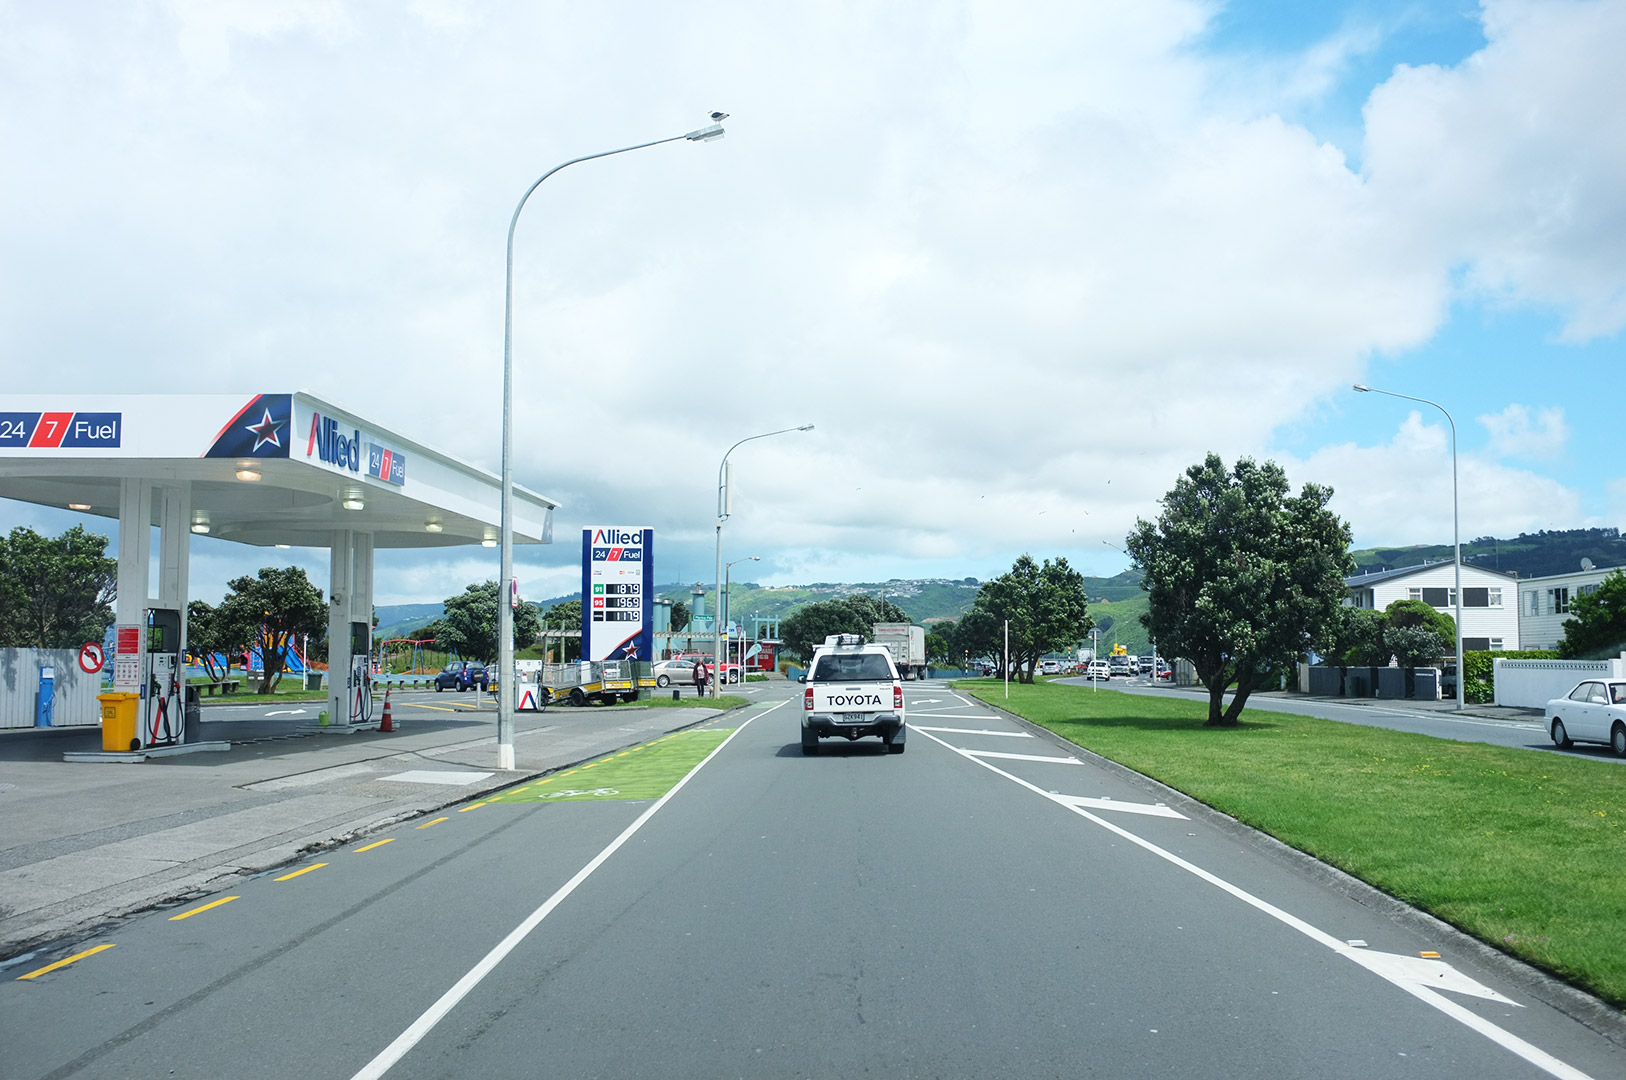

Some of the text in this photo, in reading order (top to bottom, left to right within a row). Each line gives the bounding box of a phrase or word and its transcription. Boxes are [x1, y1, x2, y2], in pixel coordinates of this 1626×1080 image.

[0, 420, 116, 439] 24 7 Fuel
[306, 412, 360, 472] Allied
[371, 452, 404, 478] 24 7 Fuel
[593, 529, 642, 545] Allied
[595, 550, 640, 559] 24 7 Fuel
[827, 695, 882, 706] TOYOTA
